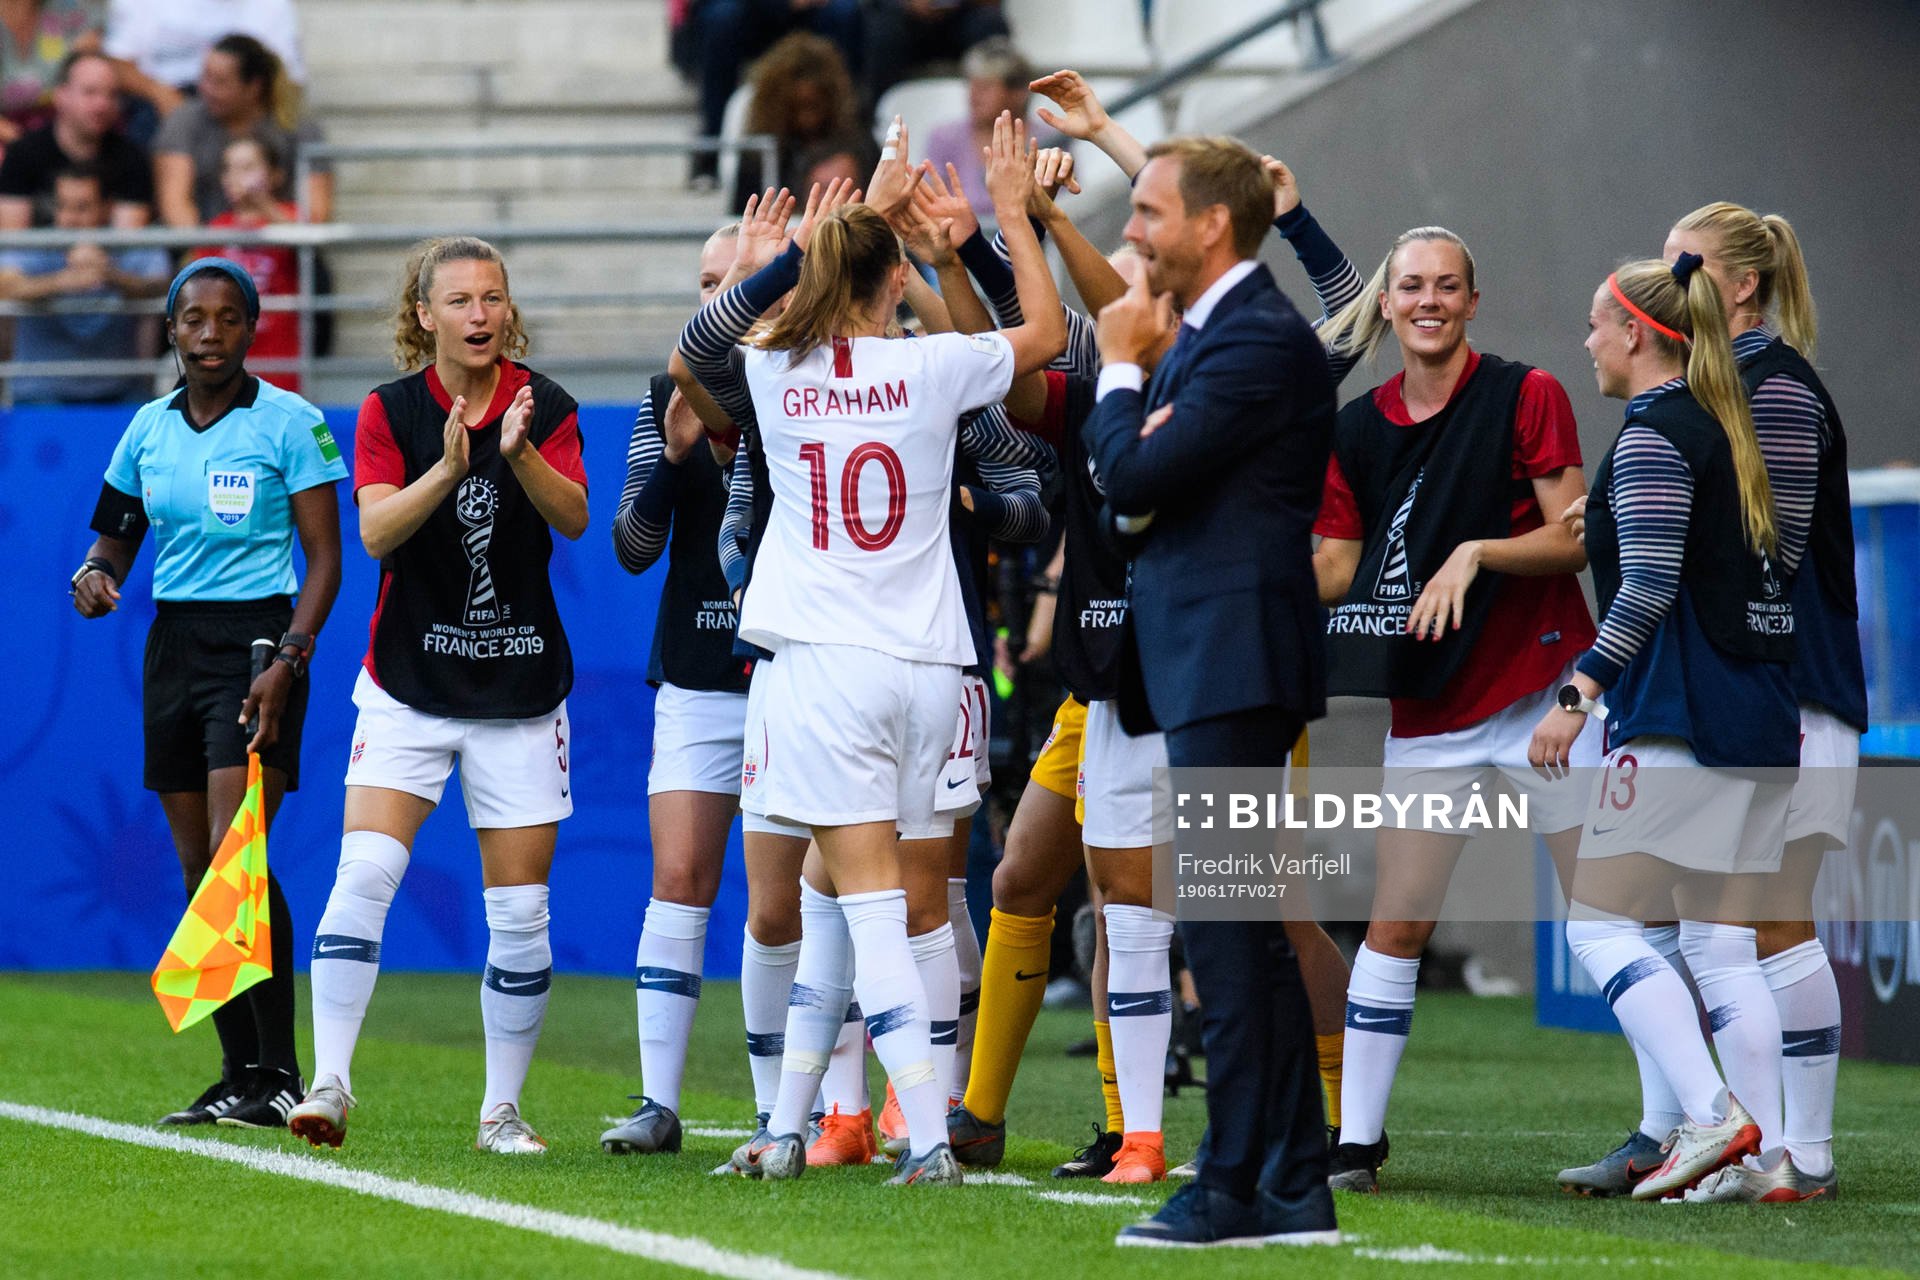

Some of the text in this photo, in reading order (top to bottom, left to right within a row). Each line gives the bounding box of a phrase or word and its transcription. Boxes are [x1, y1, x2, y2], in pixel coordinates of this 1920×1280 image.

[783, 379, 909, 417] GRAHAM
[213, 474, 249, 488] FIFA
[798, 441, 907, 551] 10
[222, 513, 240, 521] 2019
[1380, 584, 1406, 595] FIFA
[469, 609, 496, 621] FIFA
[1337, 603, 1385, 615] WOMEN'S
[432, 623, 536, 640] WOMEN'S WORLD CUP
[1326, 614, 1407, 637] FRANCE
[422, 633, 545, 661] FRANCE 2019
[555, 718, 568, 773] 5
[1598, 754, 1638, 811] 13
